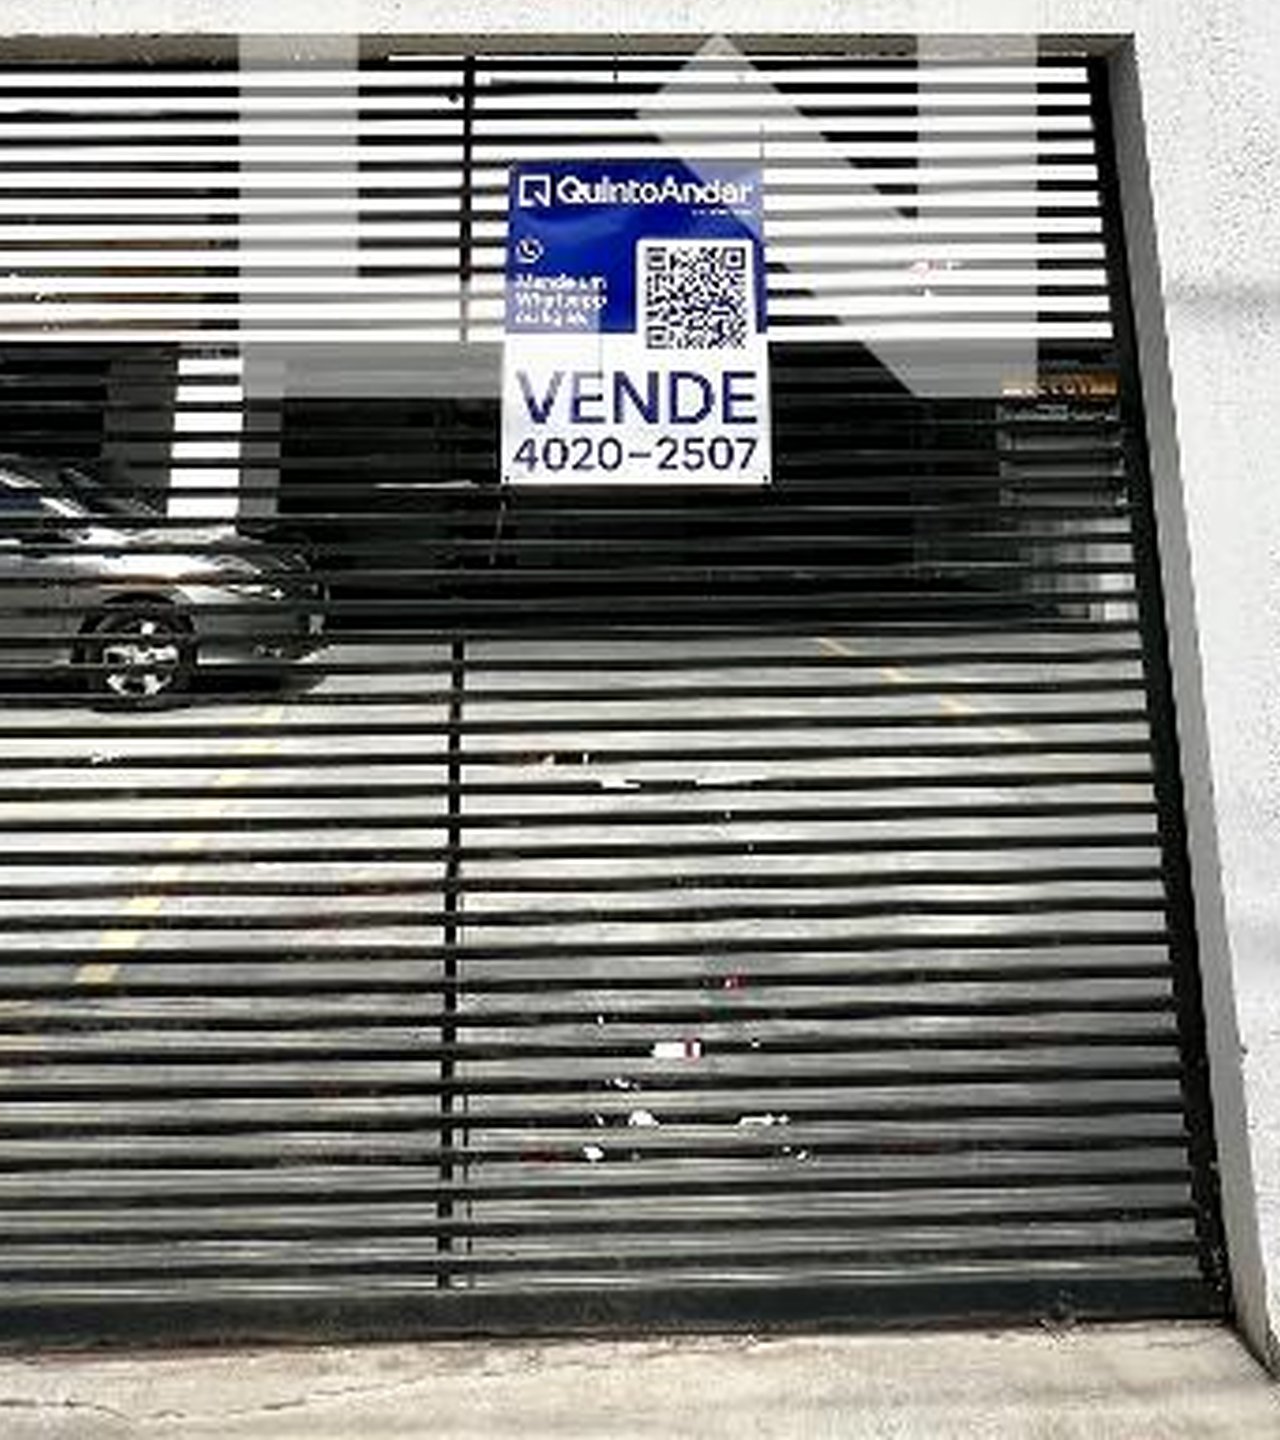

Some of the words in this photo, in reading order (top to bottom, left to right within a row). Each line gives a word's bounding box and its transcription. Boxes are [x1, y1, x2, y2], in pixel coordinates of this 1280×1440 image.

[555, 174, 753, 205] QuintoAndar
[516, 370, 758, 425] VENDE
[513, 436, 758, 473] 4020-2507
